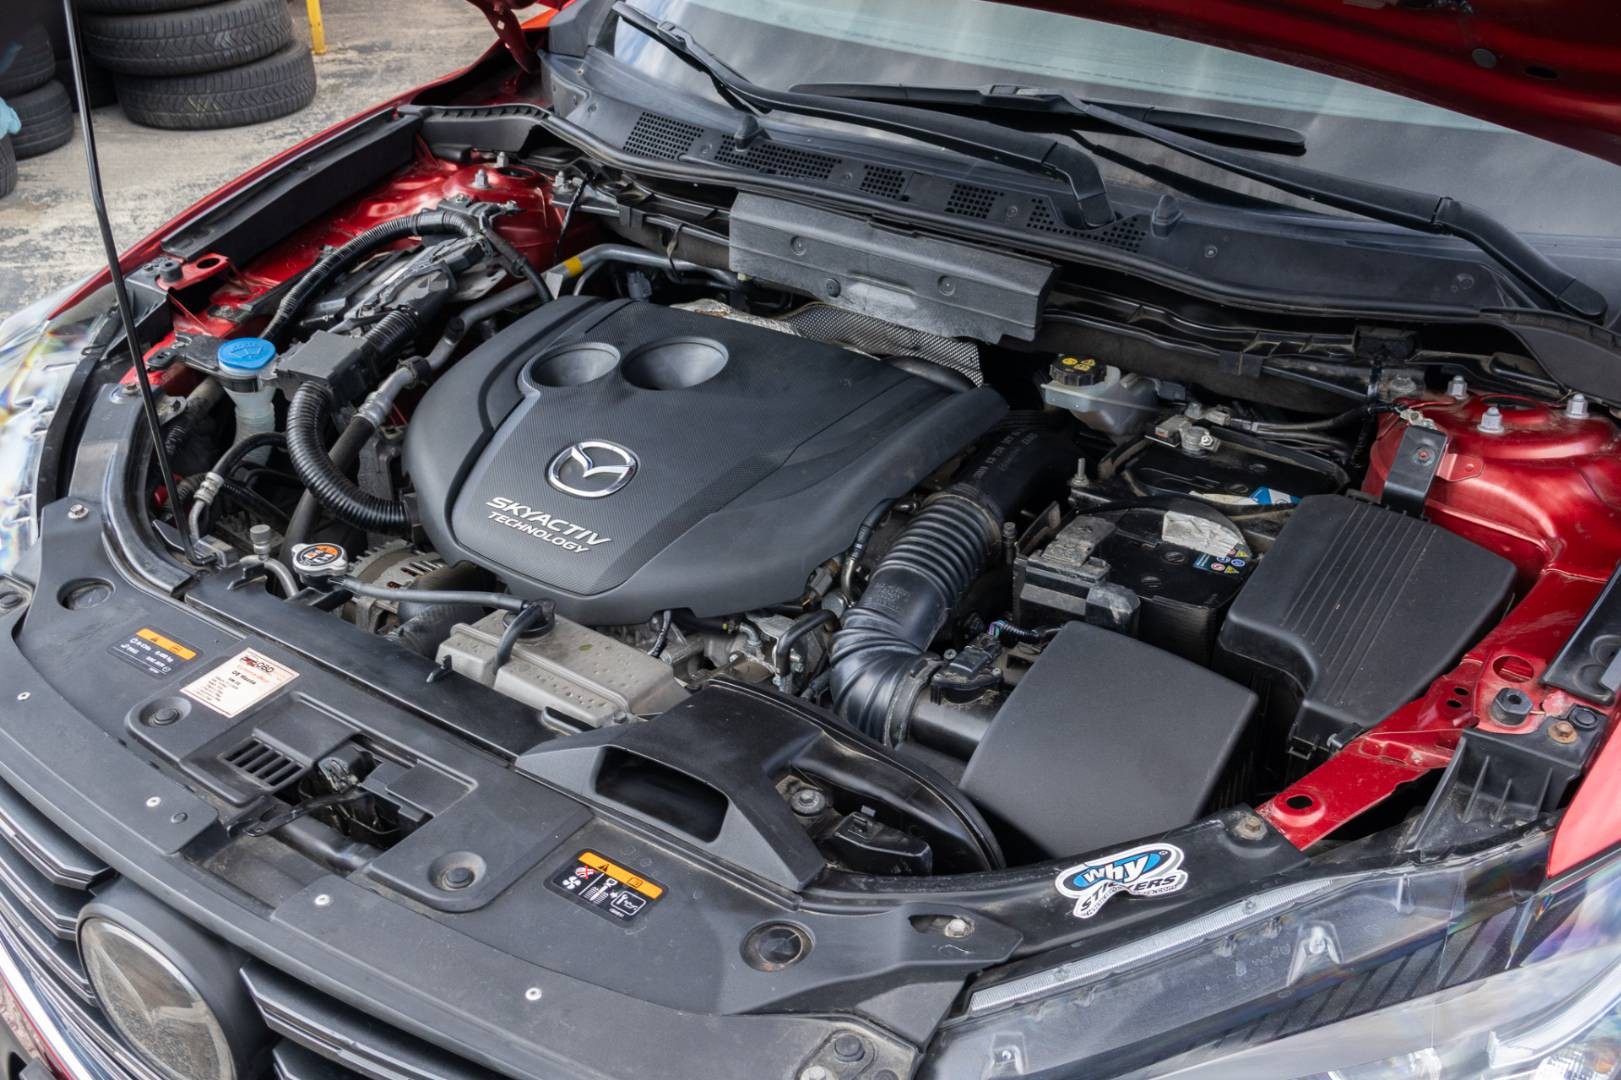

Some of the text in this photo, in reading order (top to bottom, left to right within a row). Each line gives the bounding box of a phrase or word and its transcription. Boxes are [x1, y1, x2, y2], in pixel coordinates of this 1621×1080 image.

[485, 496, 612, 545] SKYACTIV
[487, 511, 591, 553] TECHNOLOGY
[1083, 855, 1150, 883] why
